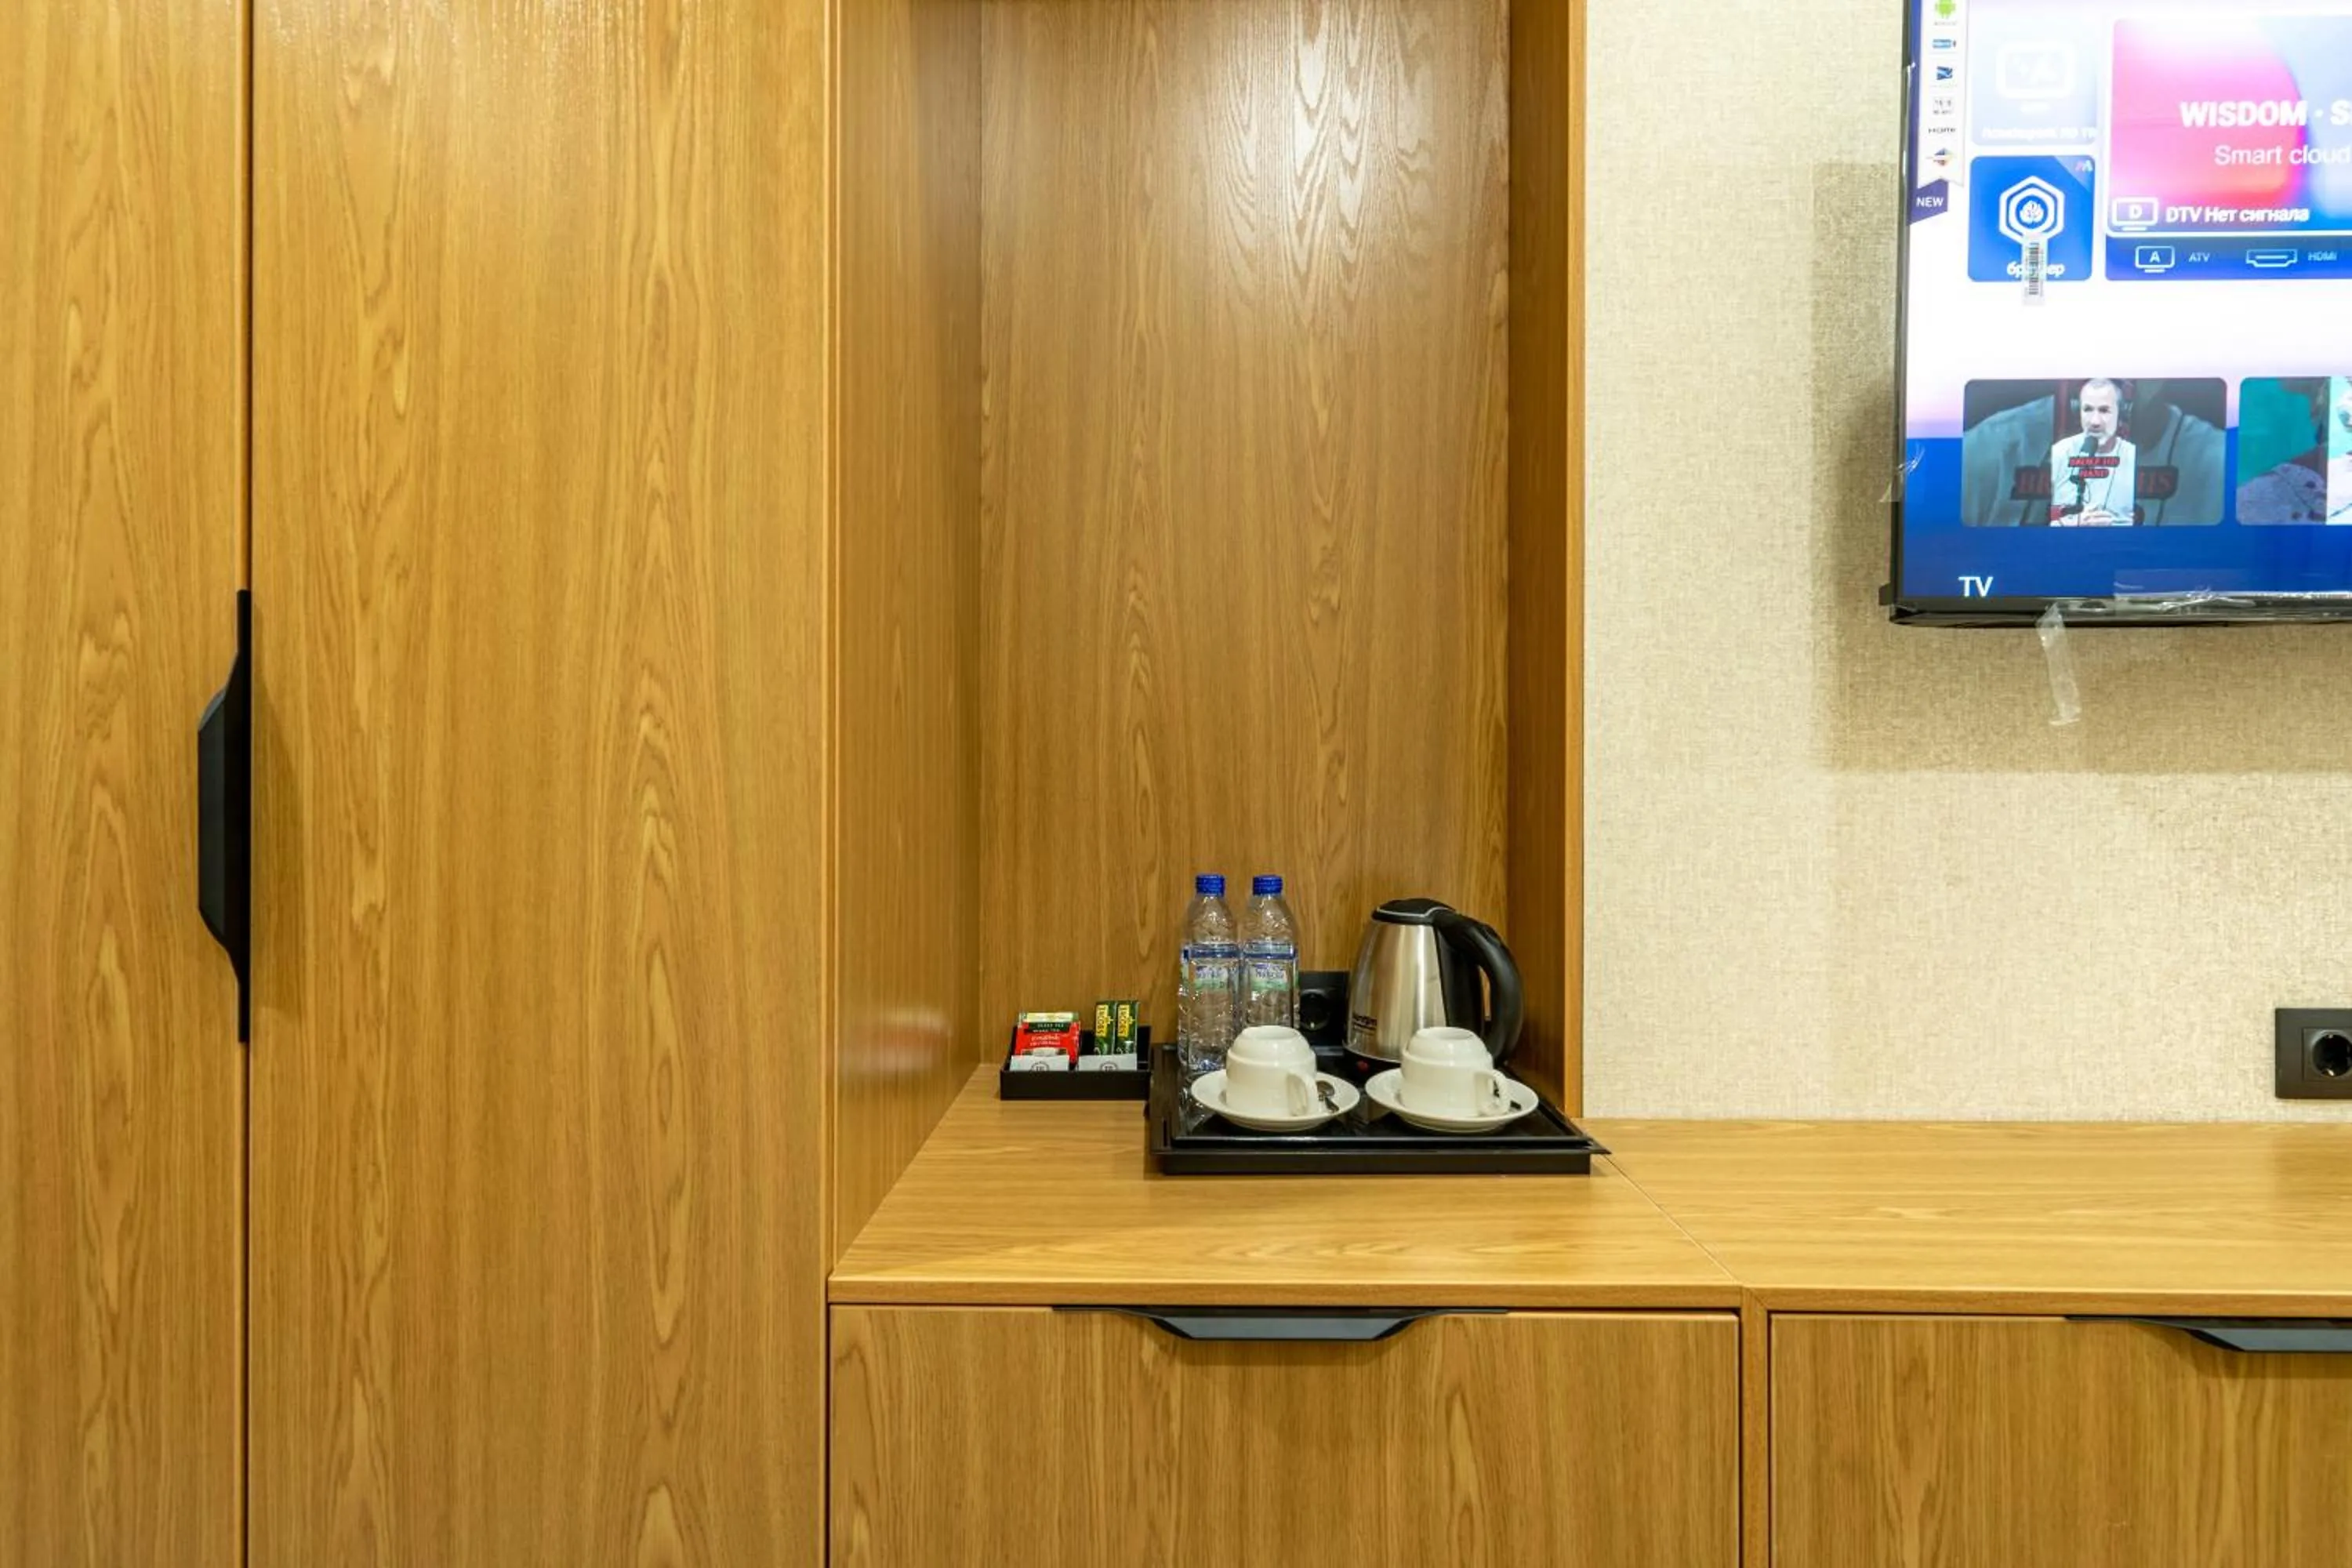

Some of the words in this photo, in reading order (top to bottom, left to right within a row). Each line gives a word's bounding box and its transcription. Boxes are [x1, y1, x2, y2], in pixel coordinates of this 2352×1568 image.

[2180, 100, 2308, 127] WISDOM
[2330, 100, 2352, 126] S
[2214, 145, 2283, 165] Smart
[2289, 143, 2351, 165] cloud
[1916, 197, 1944, 208] NEW
[2165, 206, 2204, 223] DTV
[2205, 207, 2237, 222] Нет
[2239, 208, 2310, 223] сигнала
[2188, 252, 2210, 263] ATV
[2307, 252, 2337, 262] HDMI
[2006, 261, 2065, 278] брер
[1958, 576, 1994, 597] TV
